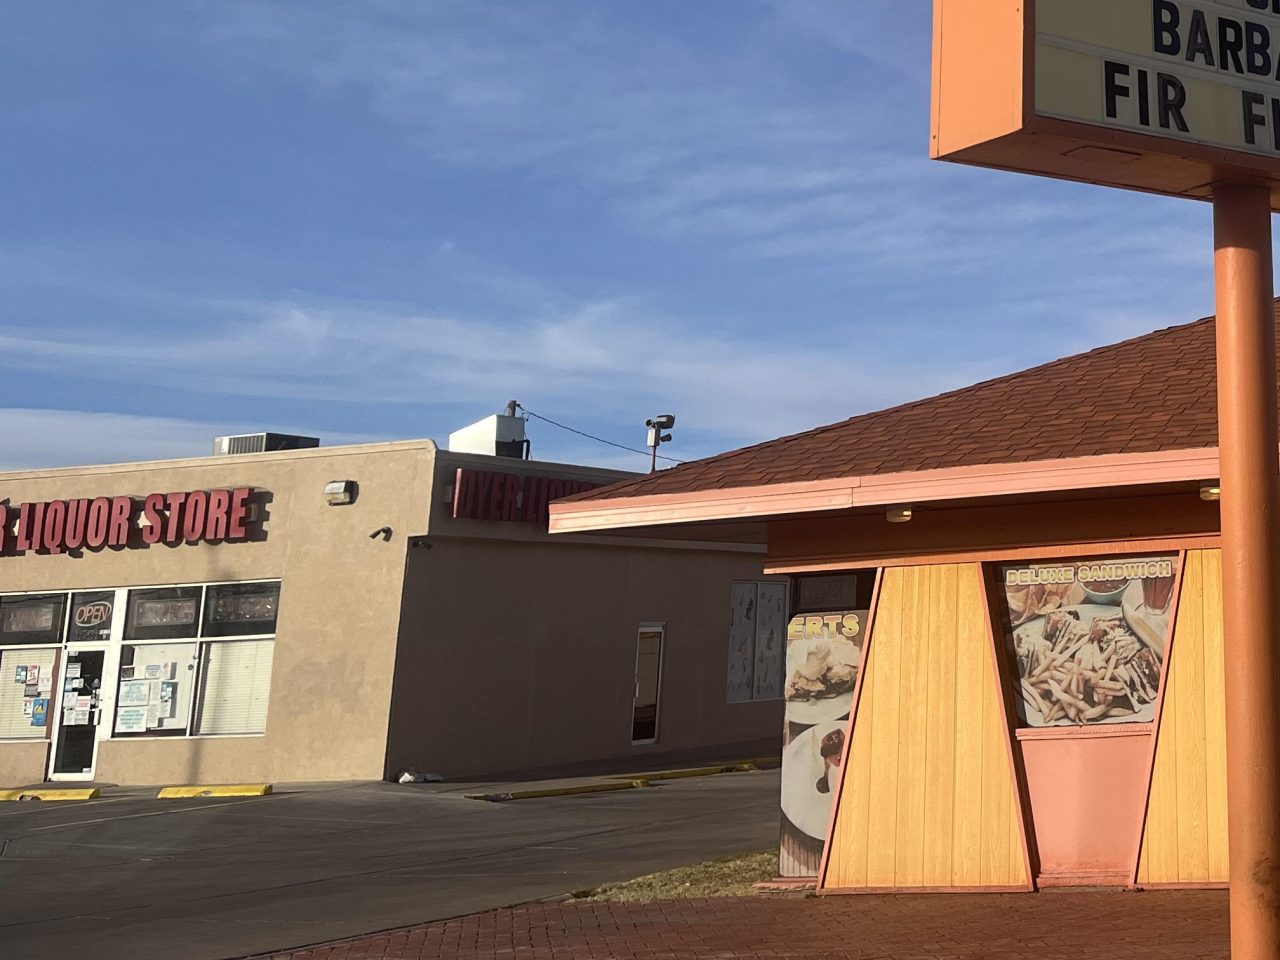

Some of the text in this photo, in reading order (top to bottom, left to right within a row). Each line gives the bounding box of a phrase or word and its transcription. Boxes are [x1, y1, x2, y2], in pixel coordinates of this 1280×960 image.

[1104, 60, 1190, 133] FIR
[16, 495, 132, 555] LIQUOR
[142, 487, 255, 544] STORE
[1006, 561, 1172, 586] DELUXE SANDWICH
[75, 604, 109, 625] OPEN
[788, 613, 860, 640] ERTS
